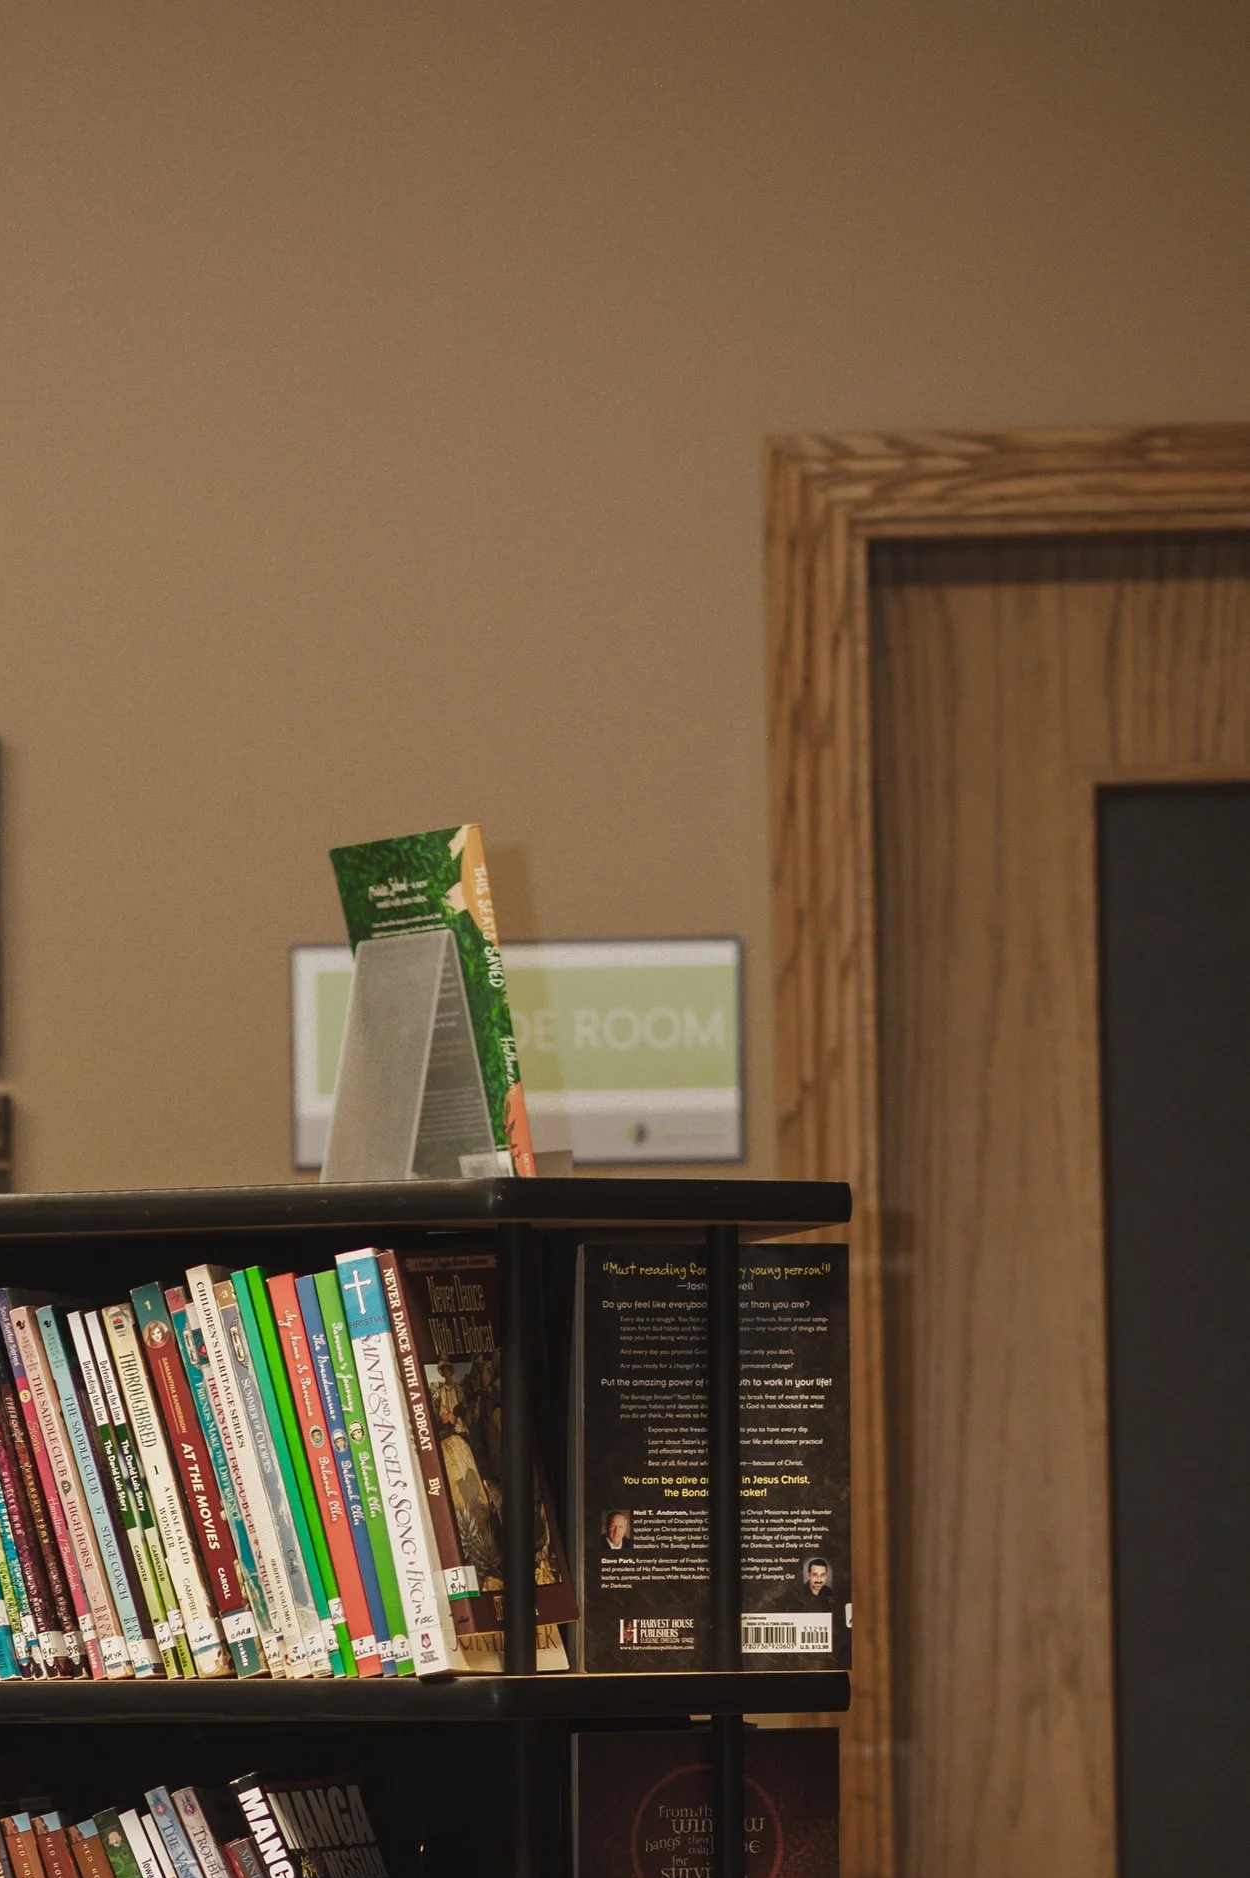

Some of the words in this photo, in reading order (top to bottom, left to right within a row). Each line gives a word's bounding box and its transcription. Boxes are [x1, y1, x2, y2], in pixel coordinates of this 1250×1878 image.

[484, 945, 505, 988] SAVED
[574, 1007, 726, 1051] ROOM
[640, 1264, 687, 1279] reading
[617, 1302, 632, 1310] you
[634, 1301, 650, 1309] feel
[312, 1334, 325, 1352] The
[383, 1268, 401, 1309] NEVER
[393, 1311, 410, 1355] DANCE
[403, 1357, 418, 1387] WITH
[413, 1403, 433, 1451] BOBCAT
[196, 1282, 219, 1349] CHILDREN'S
[228, 1405, 245, 1448] SERIES
[119, 1351, 158, 1448] THOROUGHBRED
[317, 1355, 336, 1421] Breadwinner
[181, 1443, 194, 1459] AT
[188, 1465, 206, 1491] THE
[318, 1456, 332, 1500] Deborah
[328, 1500, 338, 1522] Ellis
[623, 1476, 639, 1485] You
[642, 1477, 660, 1485] can
[676, 1476, 697, 1485] alive
[753, 1475, 779, 1485] Jesus
[67, 1501, 82, 1534] HIGH
[195, 1494, 220, 1551] MOVIES
[387, 1494, 417, 1555] SONG
[74, 1536, 94, 1571] HORSE
[640, 1619, 671, 1628] HARVEST
[674, 1619, 694, 1628] HOUSE
[640, 1629, 679, 1638] PUBLISHERS
